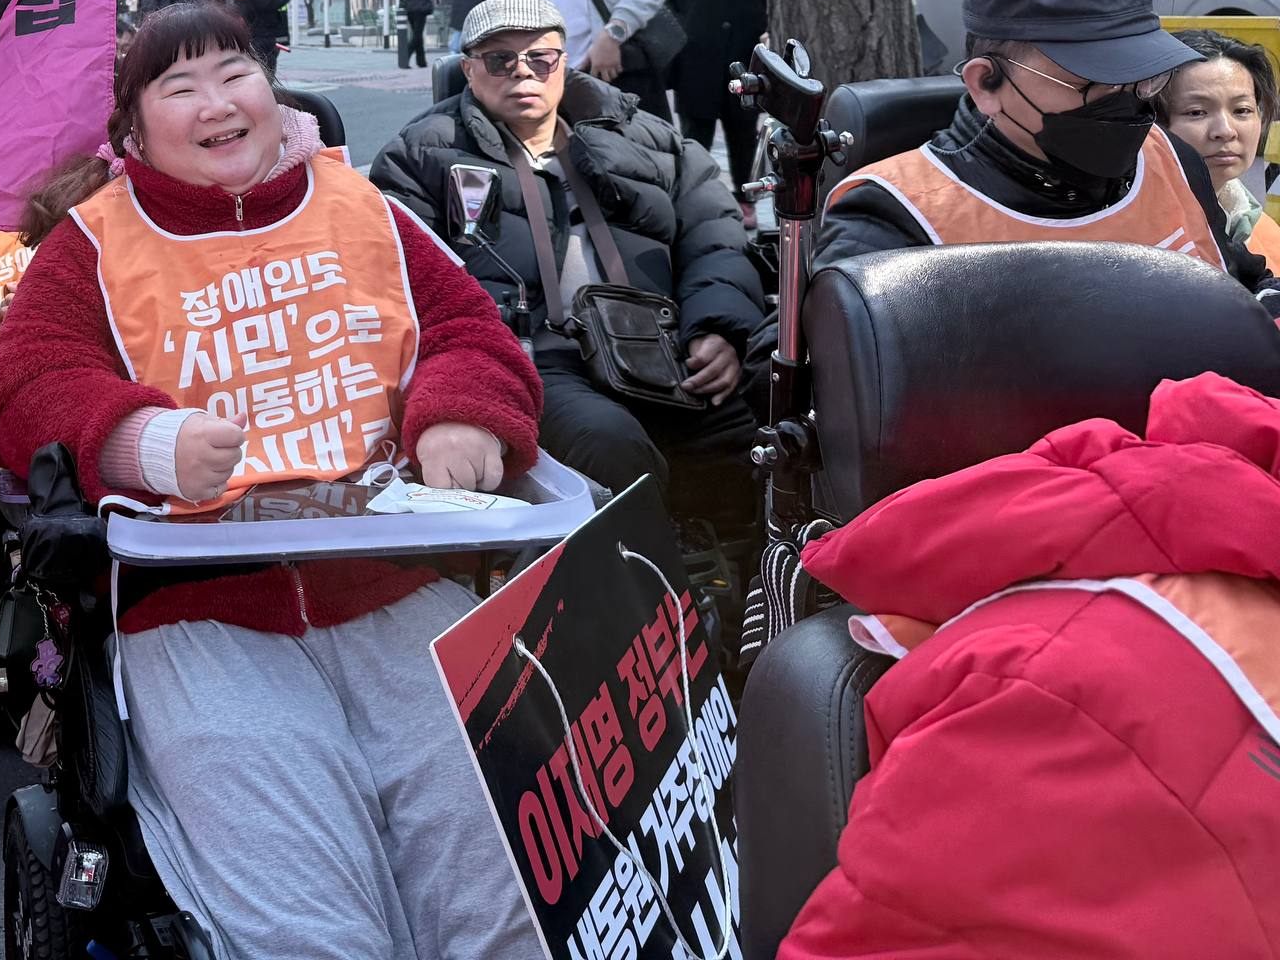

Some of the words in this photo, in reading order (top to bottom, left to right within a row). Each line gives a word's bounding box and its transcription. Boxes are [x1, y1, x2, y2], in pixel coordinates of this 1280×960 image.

[180, 251, 347, 327] 장애인도
[207, 355, 384, 432] 이동하는
[518, 681, 635, 905] 이재명
[616, 588, 709, 752] 정부는
